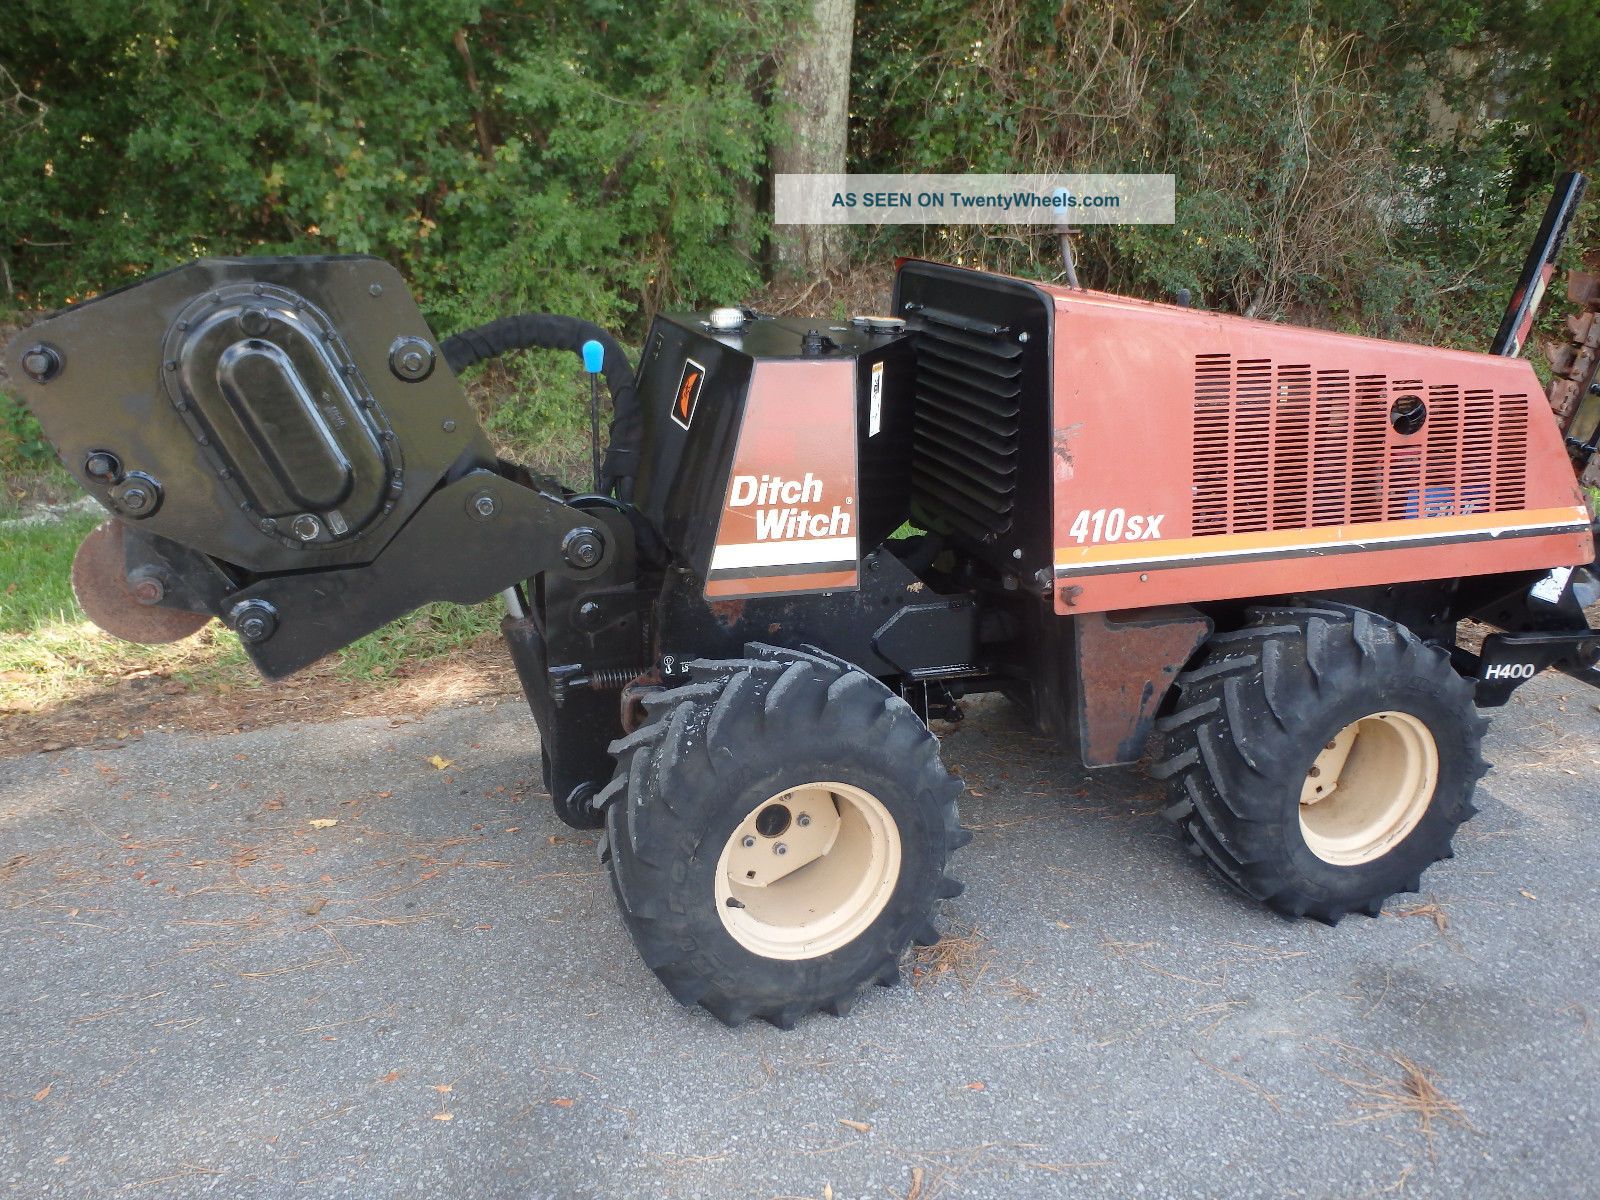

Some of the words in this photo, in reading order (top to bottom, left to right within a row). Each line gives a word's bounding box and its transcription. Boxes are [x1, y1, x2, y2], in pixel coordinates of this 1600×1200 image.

[729, 473, 823, 507] Ditch
[756, 506, 851, 540] Witch
[1486, 664, 1535, 680] H400
